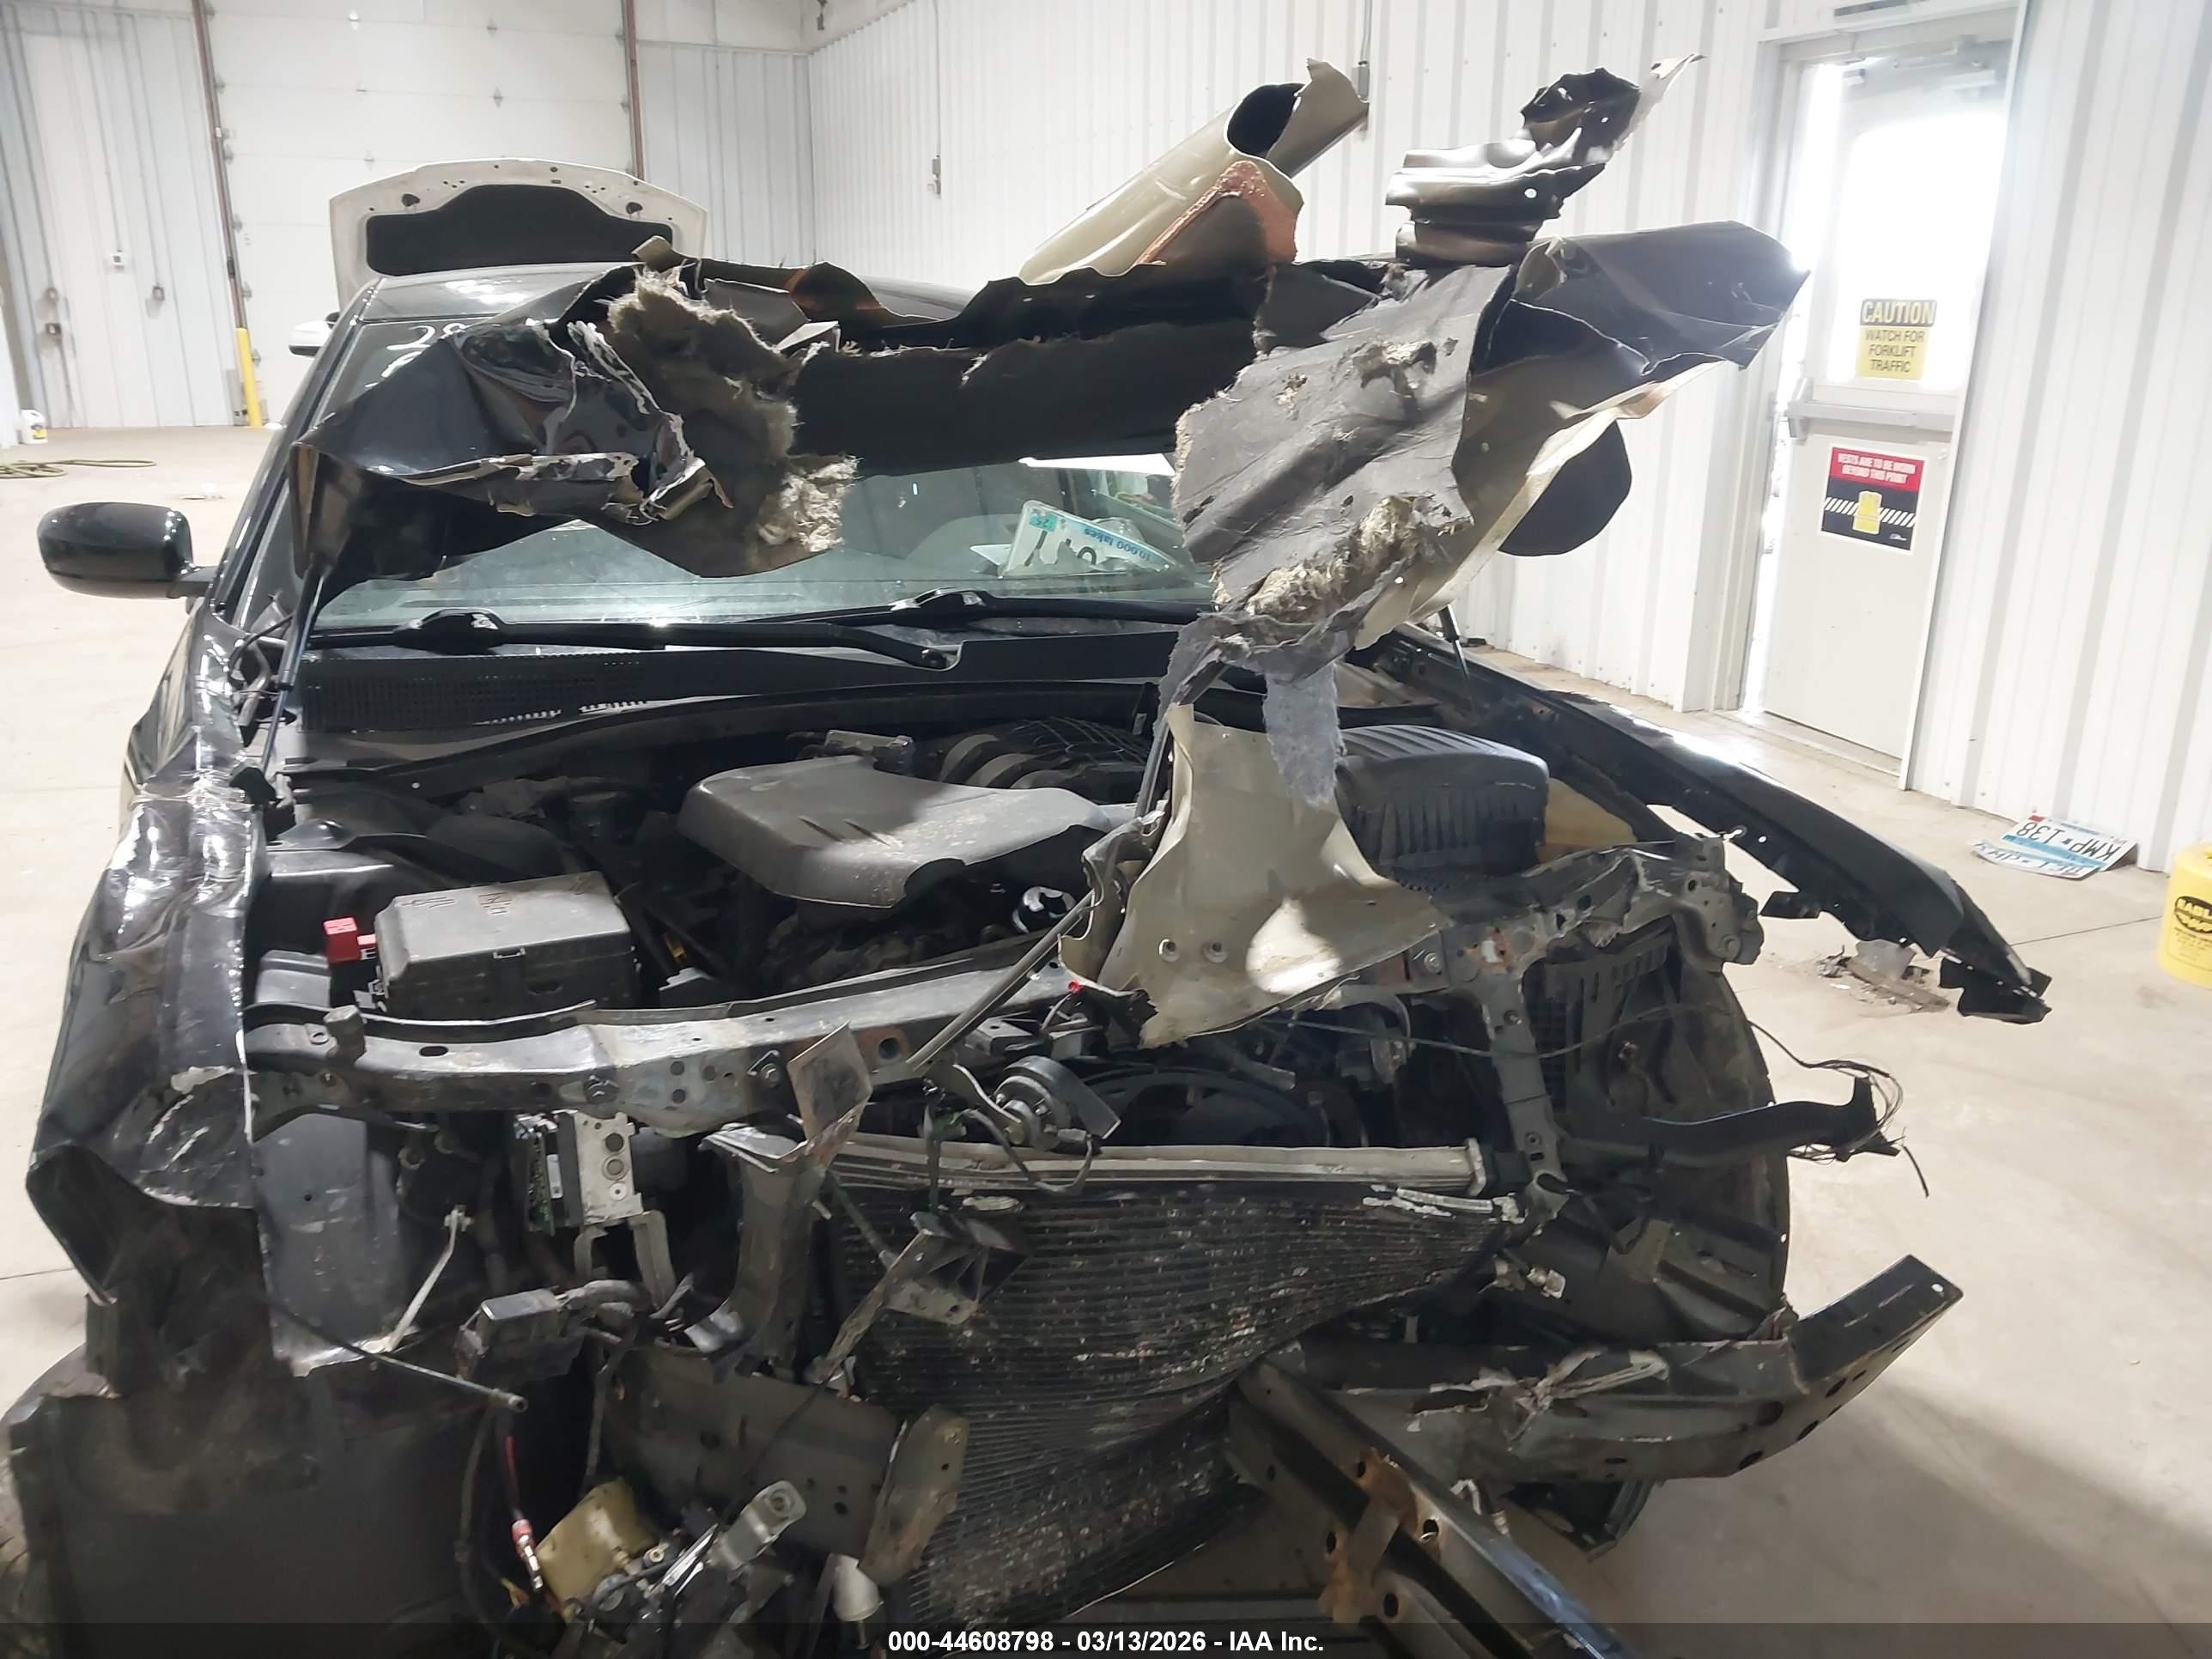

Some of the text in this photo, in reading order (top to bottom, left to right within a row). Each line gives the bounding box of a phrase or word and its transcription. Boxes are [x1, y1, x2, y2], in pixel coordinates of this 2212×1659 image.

[1862, 301, 1936, 324] CAUTION
[1864, 329, 1925, 343] WATCH FOR
[1869, 343, 1917, 357] FORKLIFT
[1869, 359, 1911, 373] TRAFFIC
[1085, 527, 1114, 547] lakes
[1116, 542, 1152, 562] 10,000
[2016, 822, 2065, 844] 138
[2069, 839, 2121, 861] KMP
